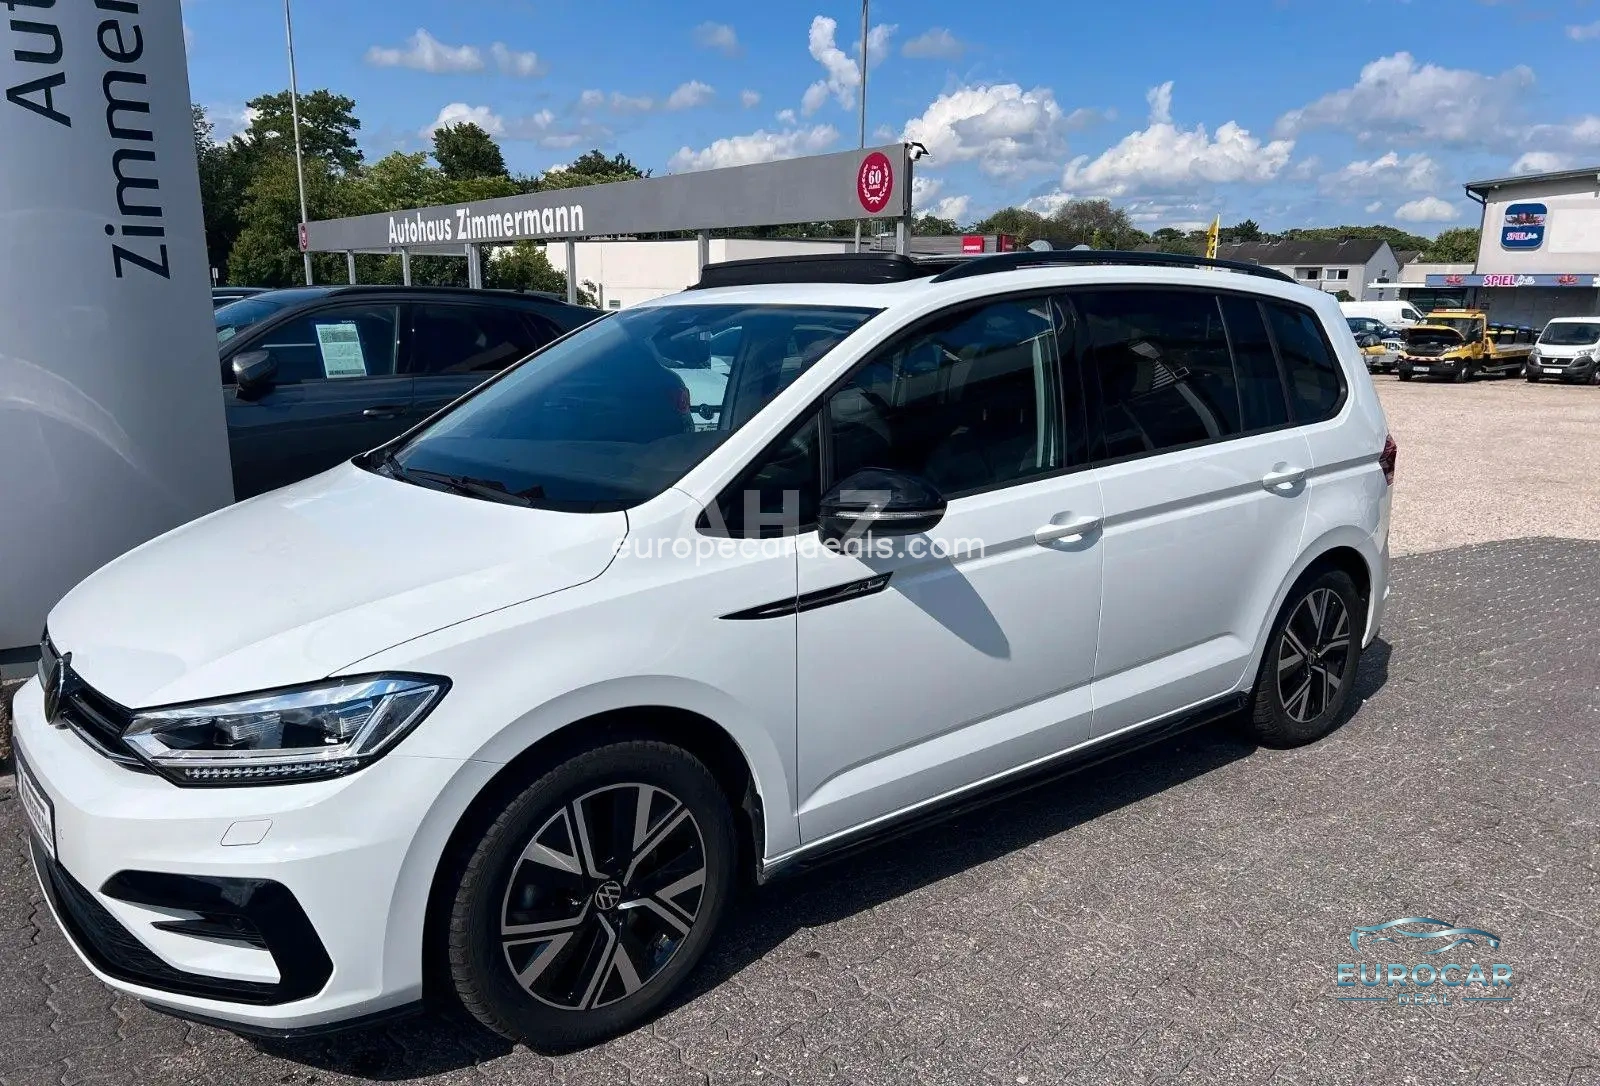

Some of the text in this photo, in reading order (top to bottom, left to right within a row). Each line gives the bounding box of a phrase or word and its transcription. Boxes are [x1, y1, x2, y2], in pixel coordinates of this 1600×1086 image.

[868, 170, 882, 185] 60
[389, 204, 584, 244] Autohaus Zimmermann
[1483, 275, 1517, 288] SPIEL
